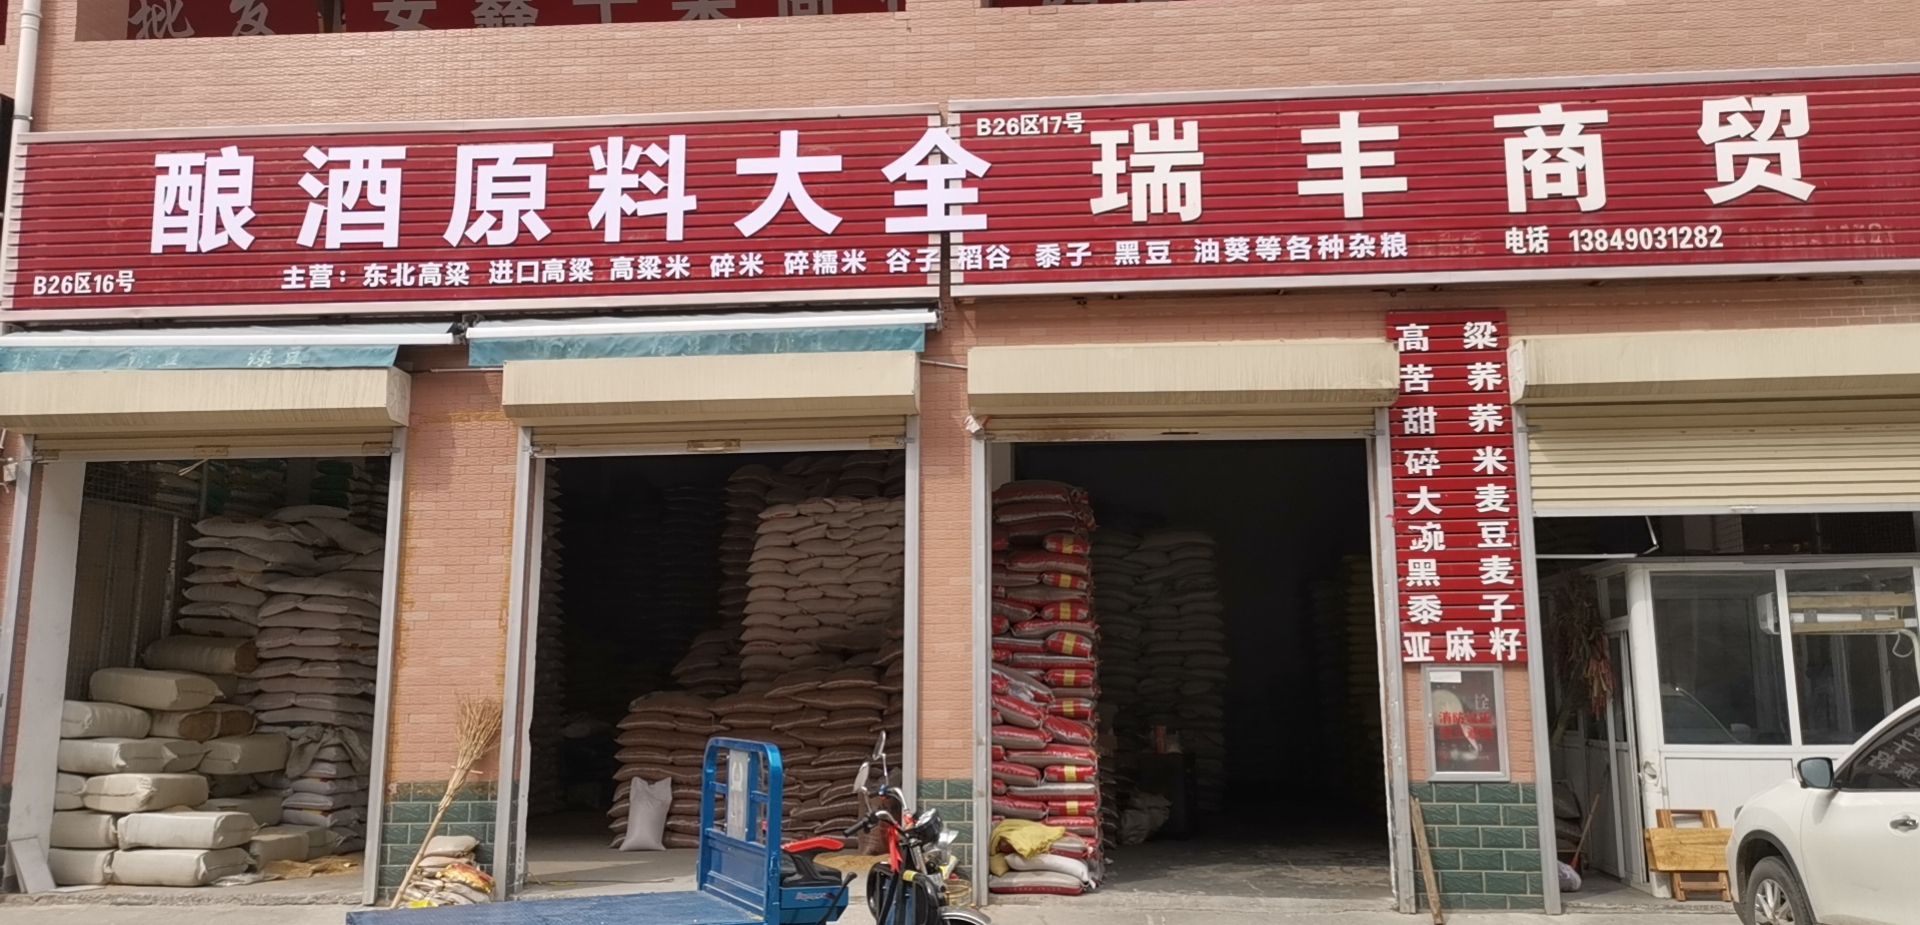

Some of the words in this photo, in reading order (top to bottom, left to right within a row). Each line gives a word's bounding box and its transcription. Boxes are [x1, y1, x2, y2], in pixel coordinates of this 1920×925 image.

[976, 112, 1085, 137] B26区17号
[1090, 95, 1817, 223] 瑞丰商贸
[150, 127, 992, 253] 酿酒原料大全
[1505, 226, 1550, 254] 电话
[1568, 225, 1724, 252] 13849031282
[362, 261, 470, 288] 东北高粱
[488, 258, 595, 285] 进口高粱
[609, 255, 691, 281] 高粱米
[710, 252, 765, 279] 碎米
[783, 249, 867, 276] 碎糯米
[886, 247, 940, 274] 谷子
[958, 244, 1011, 271] 稻谷
[1035, 242, 1092, 269] 黍子
[1114, 240, 1172, 266] 黑豆
[1193, 232, 1408, 264] 油葵等各种杂粮
[33, 270, 136, 296] B26区16号
[1396, 322, 1498, 352] 高粱
[1400, 362, 1504, 393] 苦荞
[1402, 403, 1504, 434] 甜荞
[1404, 446, 1508, 476] 碎米
[1407, 484, 1511, 515] 大麦
[1406, 555, 1515, 587] 黑麦
[1407, 594, 1516, 625] 黍子
[1403, 627, 1522, 662] 亚麻籽
